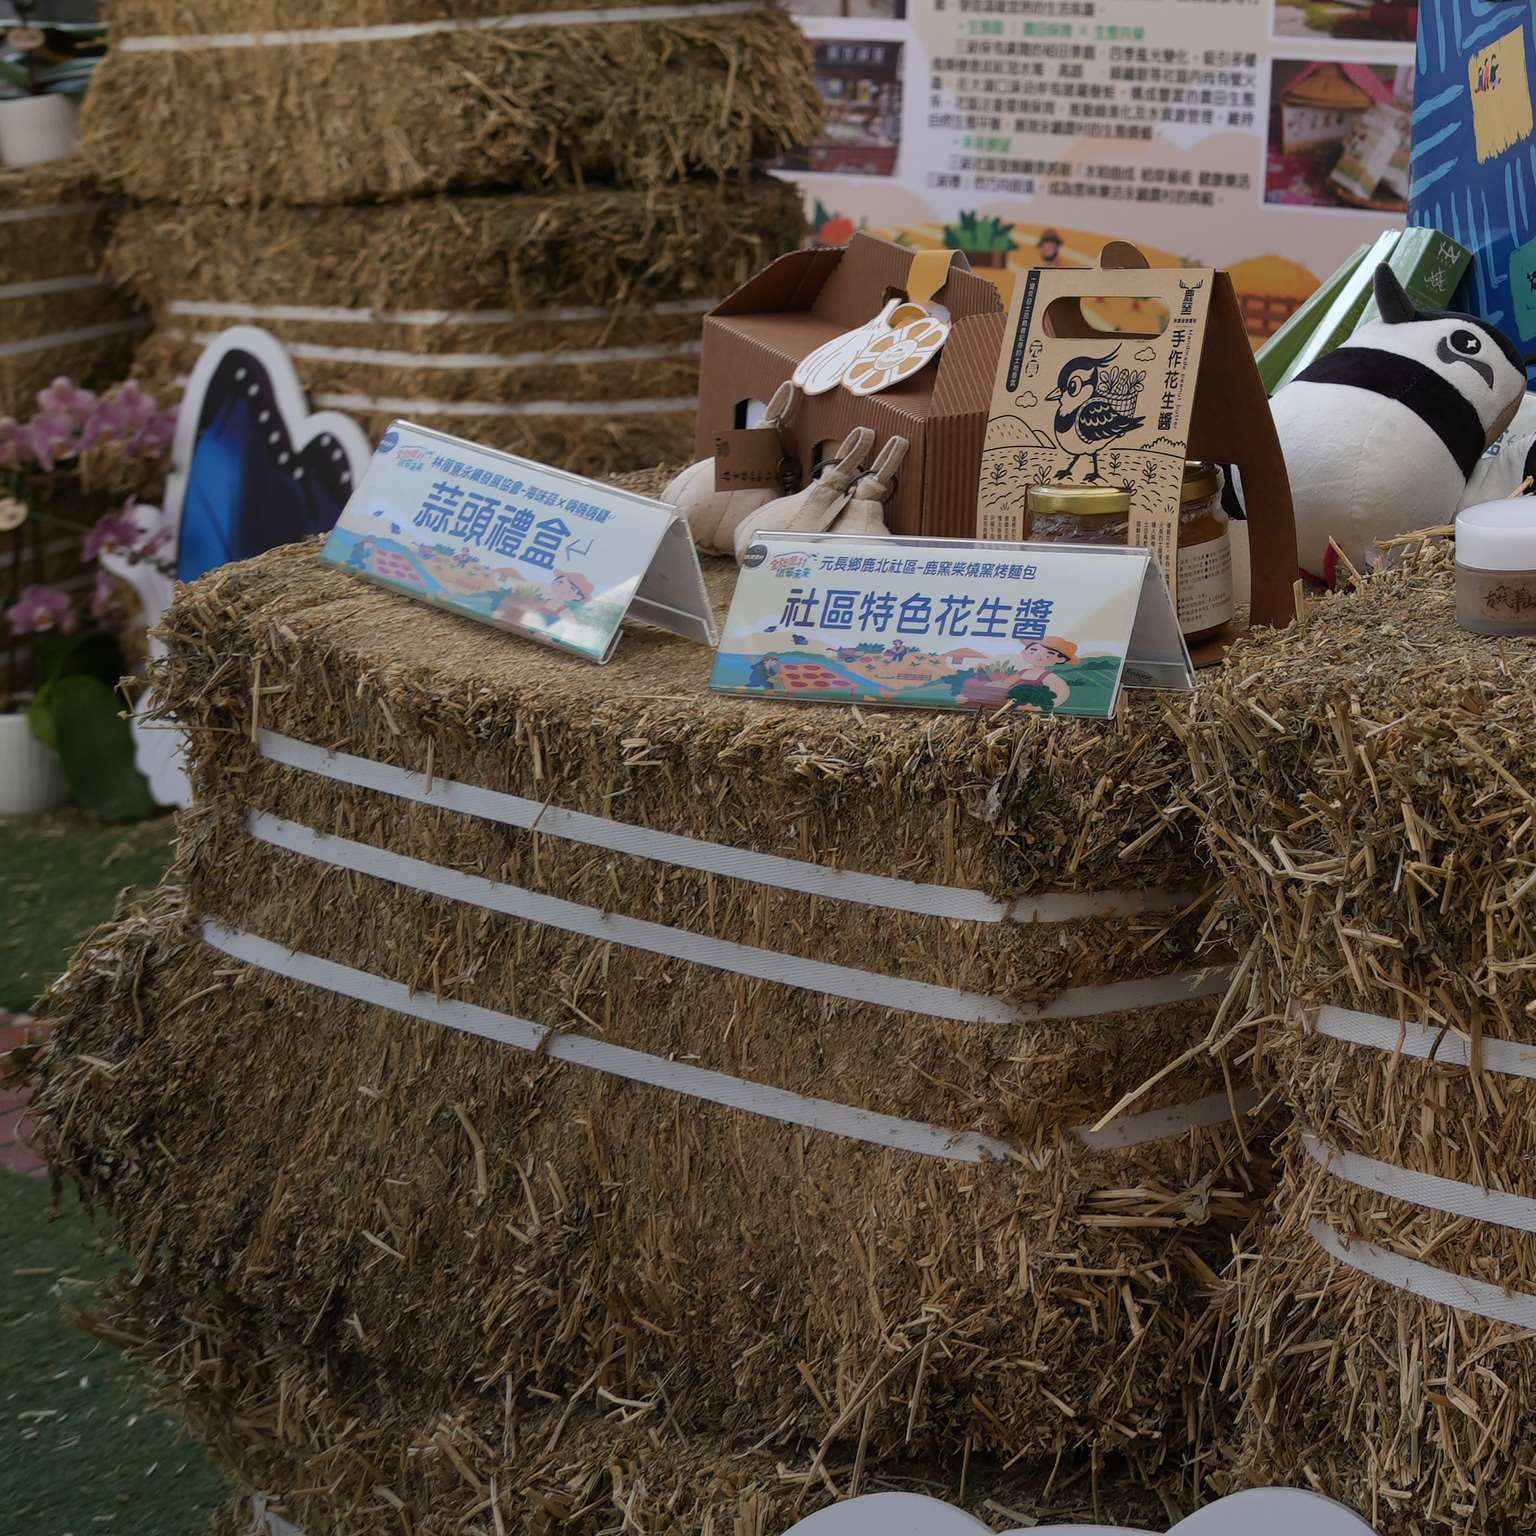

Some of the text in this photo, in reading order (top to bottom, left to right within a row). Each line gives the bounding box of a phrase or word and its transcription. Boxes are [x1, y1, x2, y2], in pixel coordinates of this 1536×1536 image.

[1158, 329, 1186, 431] 手作花生醬
[413, 482, 572, 570] 蒜頭禮盒
[780, 587, 1053, 639] 社區特色花生醬
